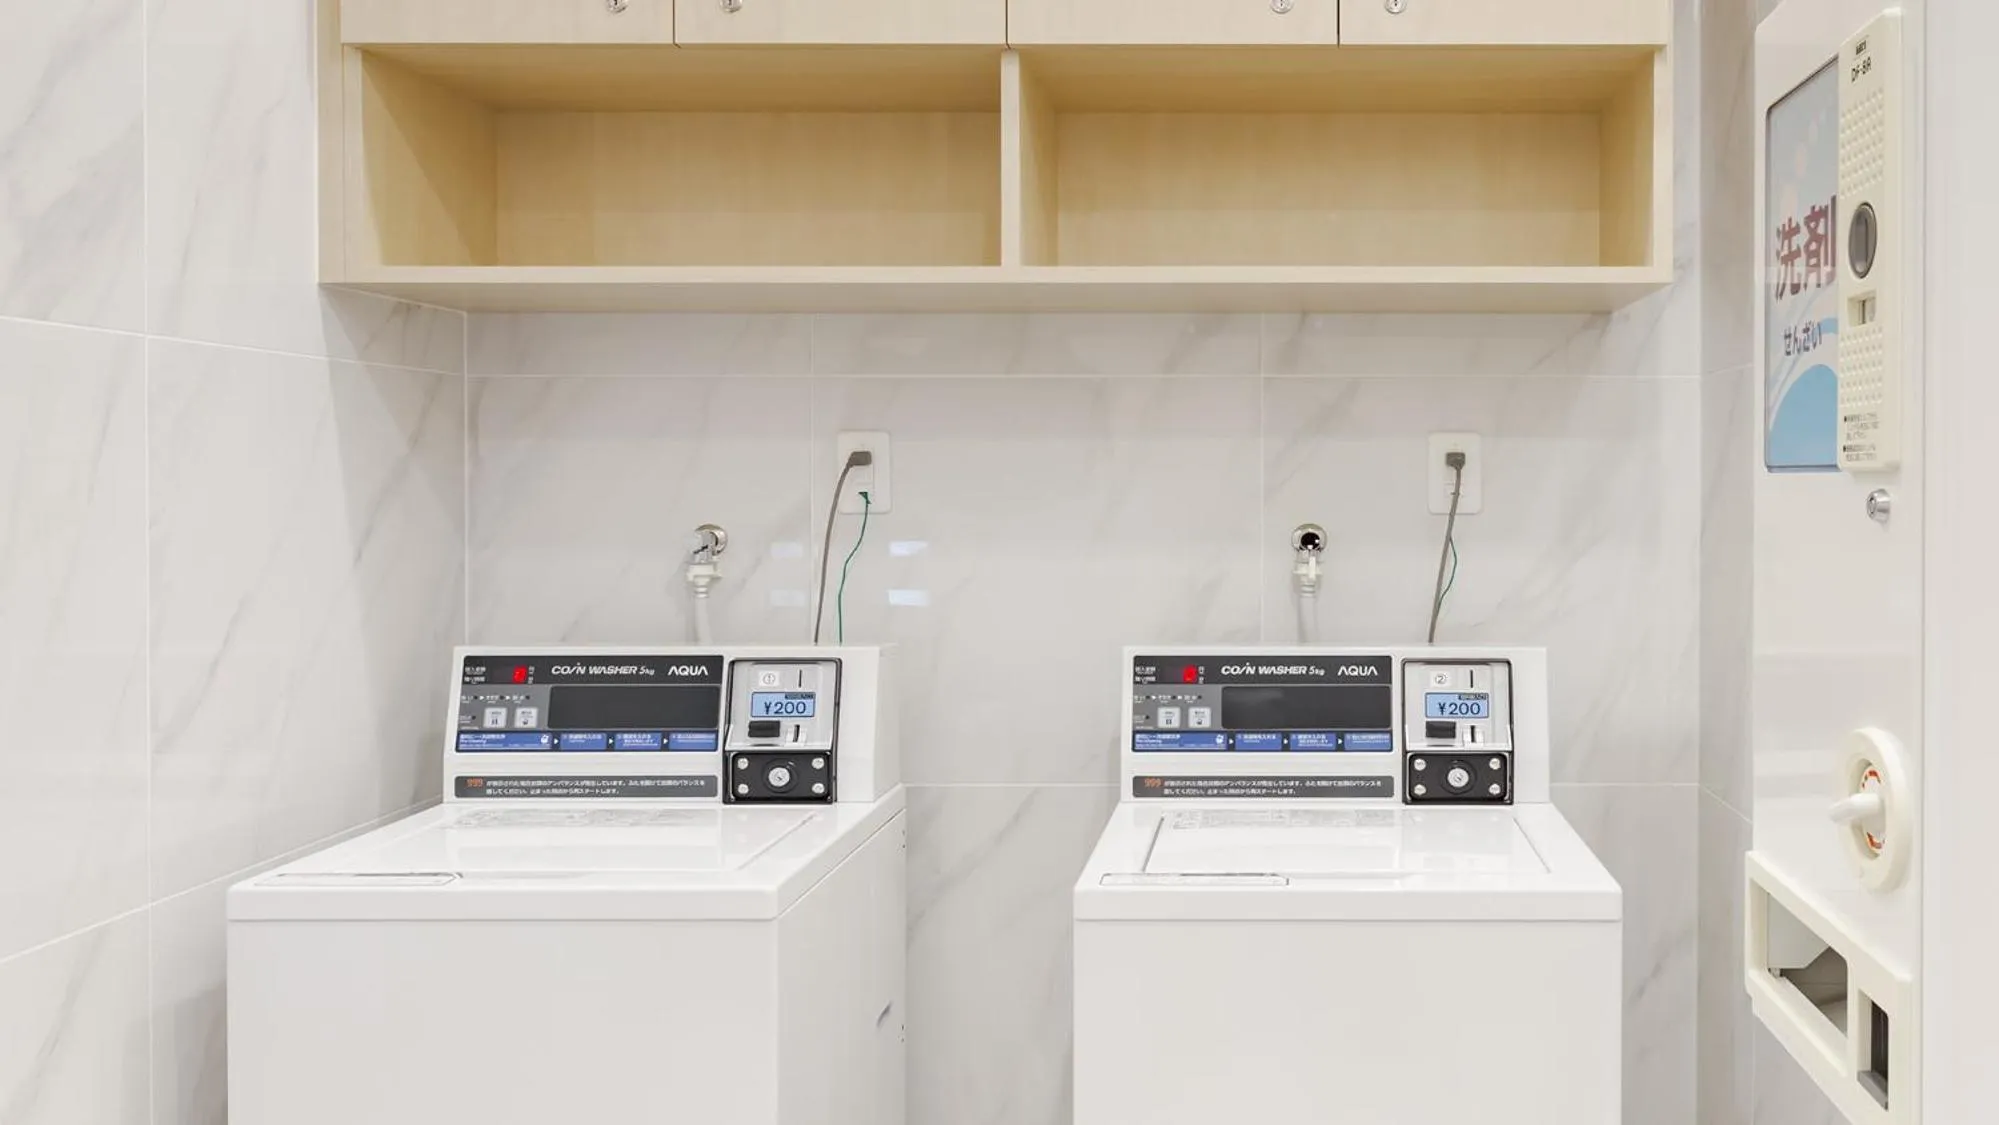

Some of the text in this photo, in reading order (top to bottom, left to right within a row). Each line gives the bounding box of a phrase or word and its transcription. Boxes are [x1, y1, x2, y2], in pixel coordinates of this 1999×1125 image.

[1775, 195, 1838, 301] 洗剤
[1783, 320, 1823, 357] せんざい
[588, 665, 637, 674] WASHER
[668, 665, 708, 675] AQUA
[1258, 665, 1307, 674] WASHER
[1337, 665, 1378, 675] AQUA
[764, 701, 807, 715] ¥200
[1438, 702, 1481, 716] ¥200
